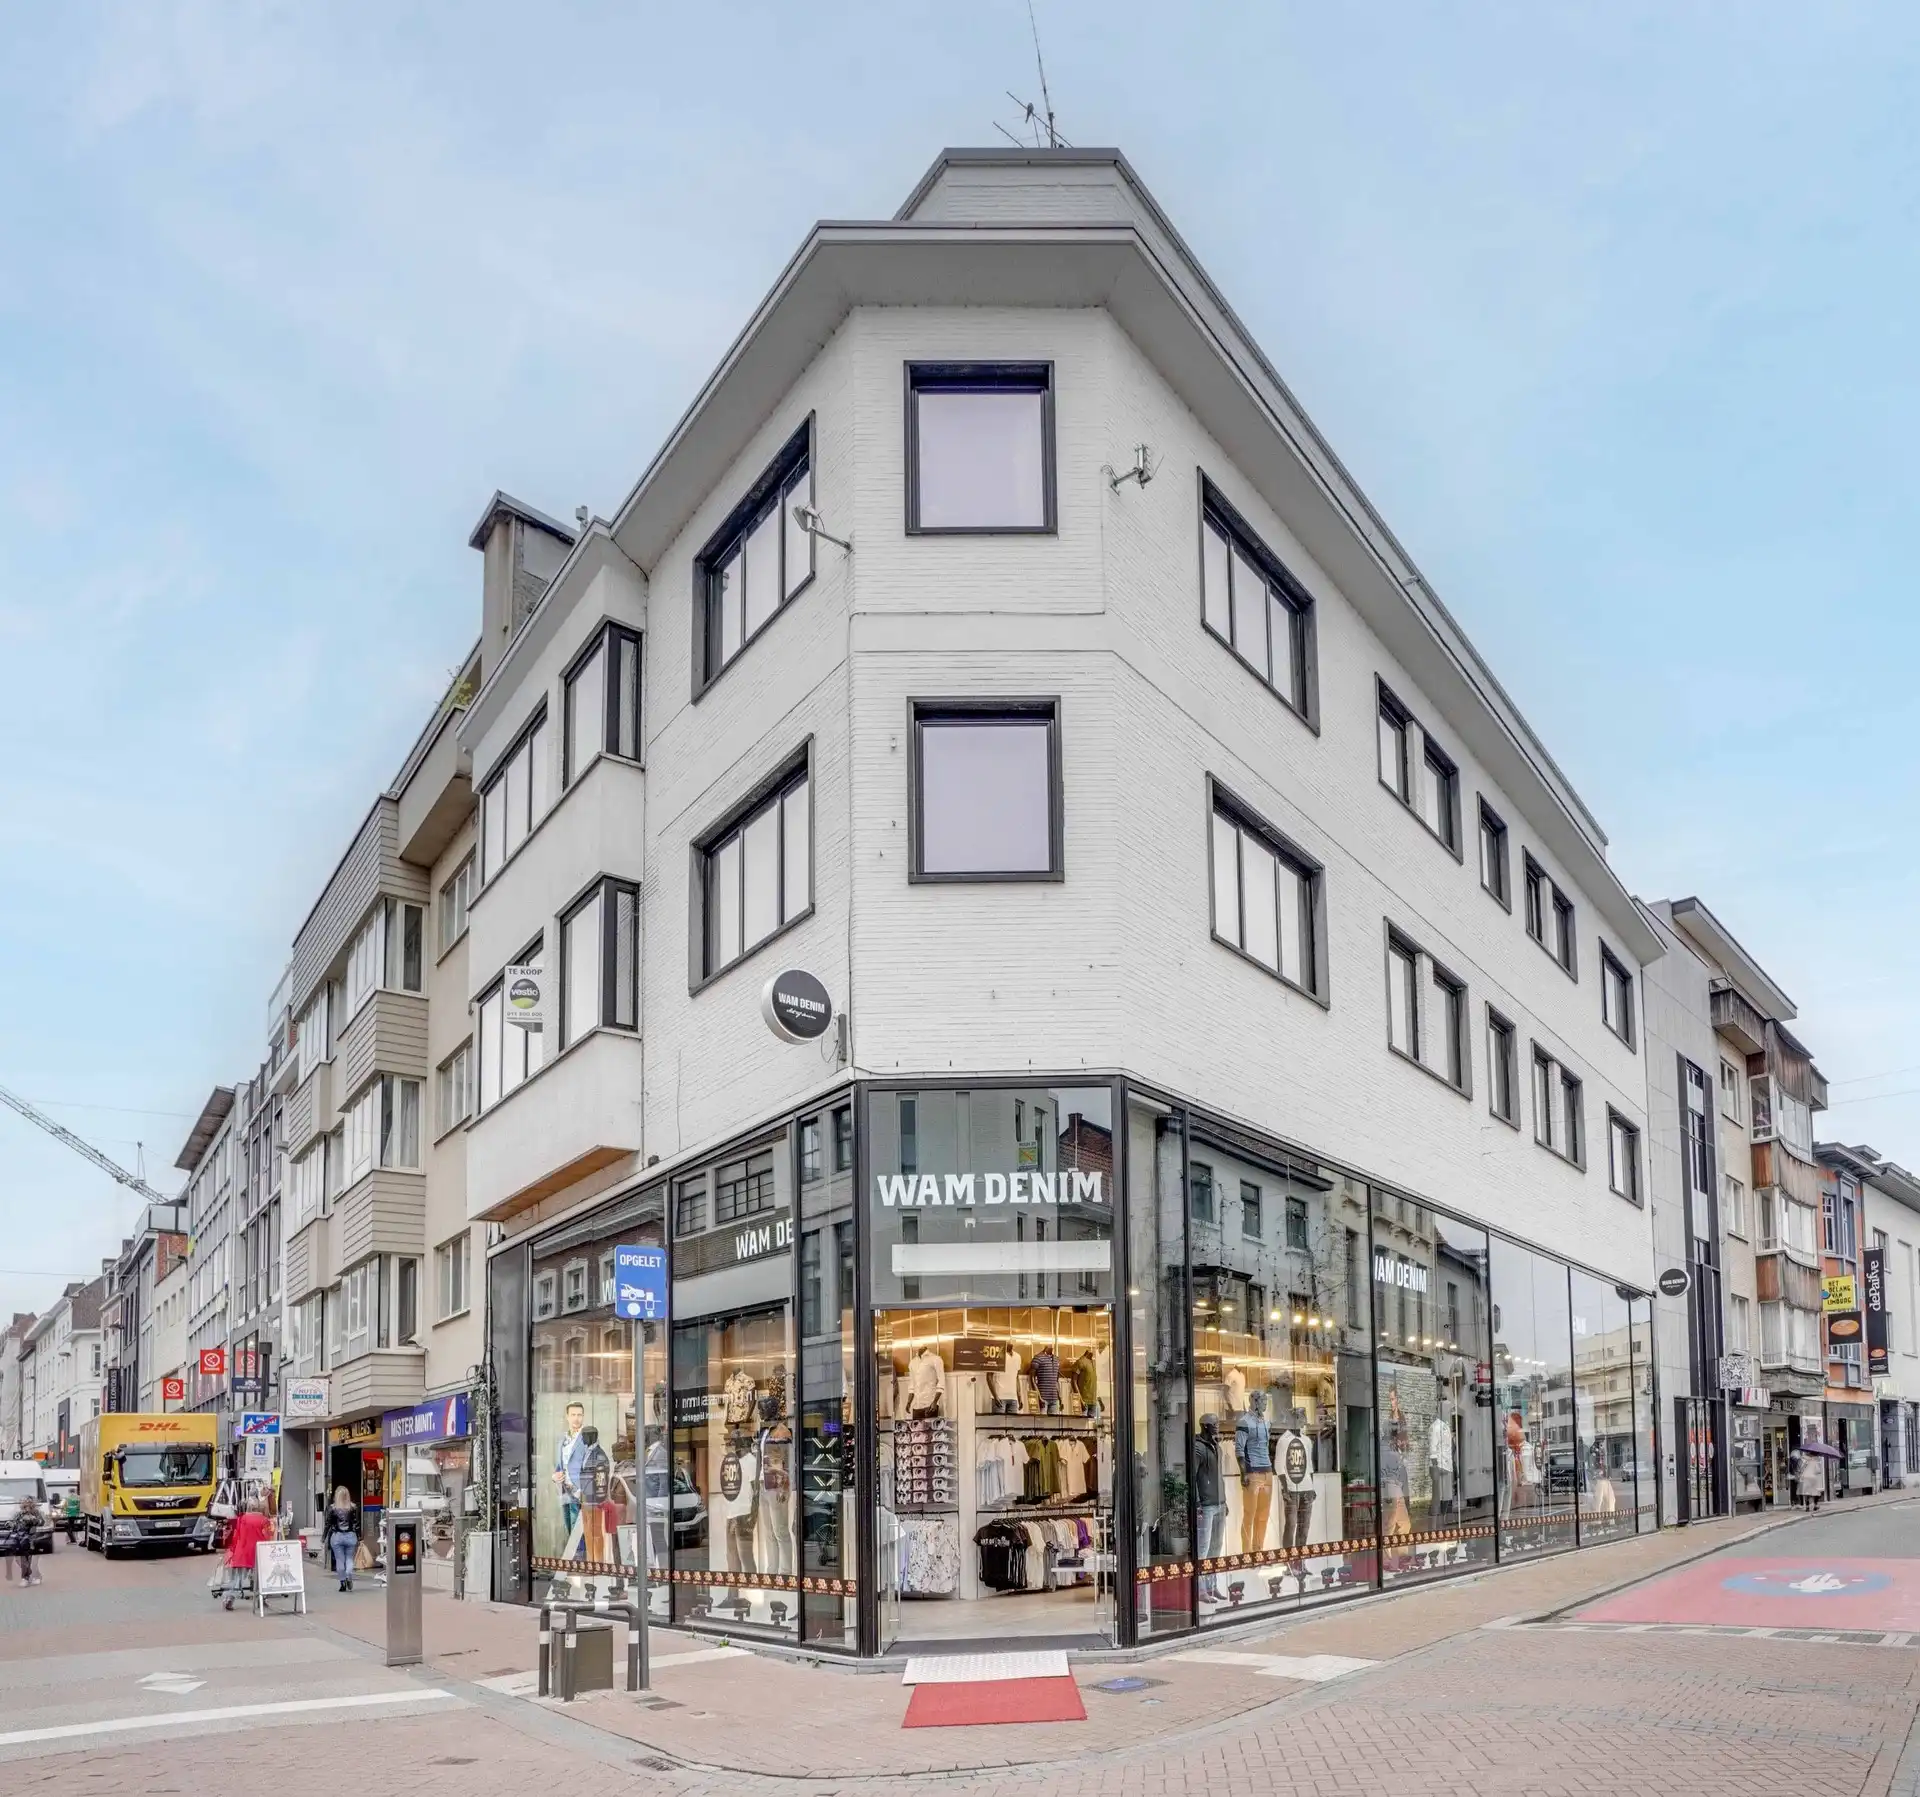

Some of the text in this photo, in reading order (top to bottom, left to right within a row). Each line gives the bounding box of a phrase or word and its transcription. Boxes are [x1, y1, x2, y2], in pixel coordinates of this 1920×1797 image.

[520, 968, 542, 976] KOOP
[778, 992, 798, 1007] WAM
[800, 998, 825, 1014] DENIM
[877, 1171, 1103, 1206] WAM DENIM
[735, 1225, 771, 1260] WAM
[619, 1254, 662, 1268] OPGELET
[1397, 1261, 1427, 1294] DENIM
[139, 1422, 182, 1432] DHL
[390, 1416, 414, 1438] MISTER
